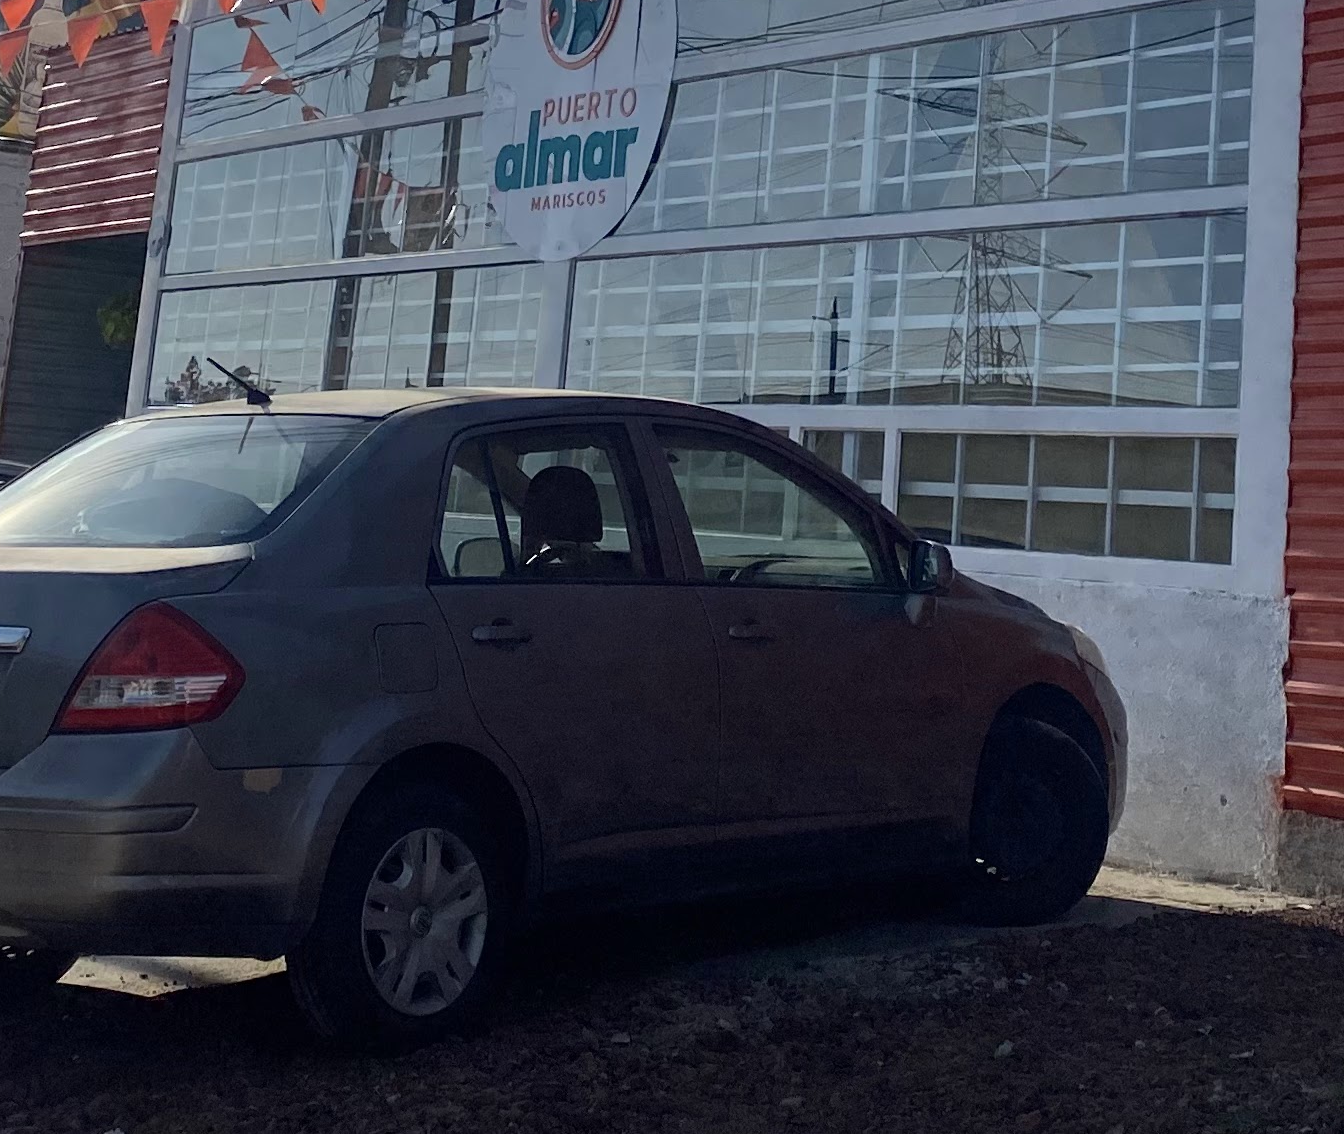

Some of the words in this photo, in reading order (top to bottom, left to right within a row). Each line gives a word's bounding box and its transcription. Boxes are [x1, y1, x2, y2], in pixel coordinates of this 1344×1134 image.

[542, 87, 638, 127] PUERTO
[494, 109, 640, 193] almar
[530, 188, 607, 212] MARISCOS
